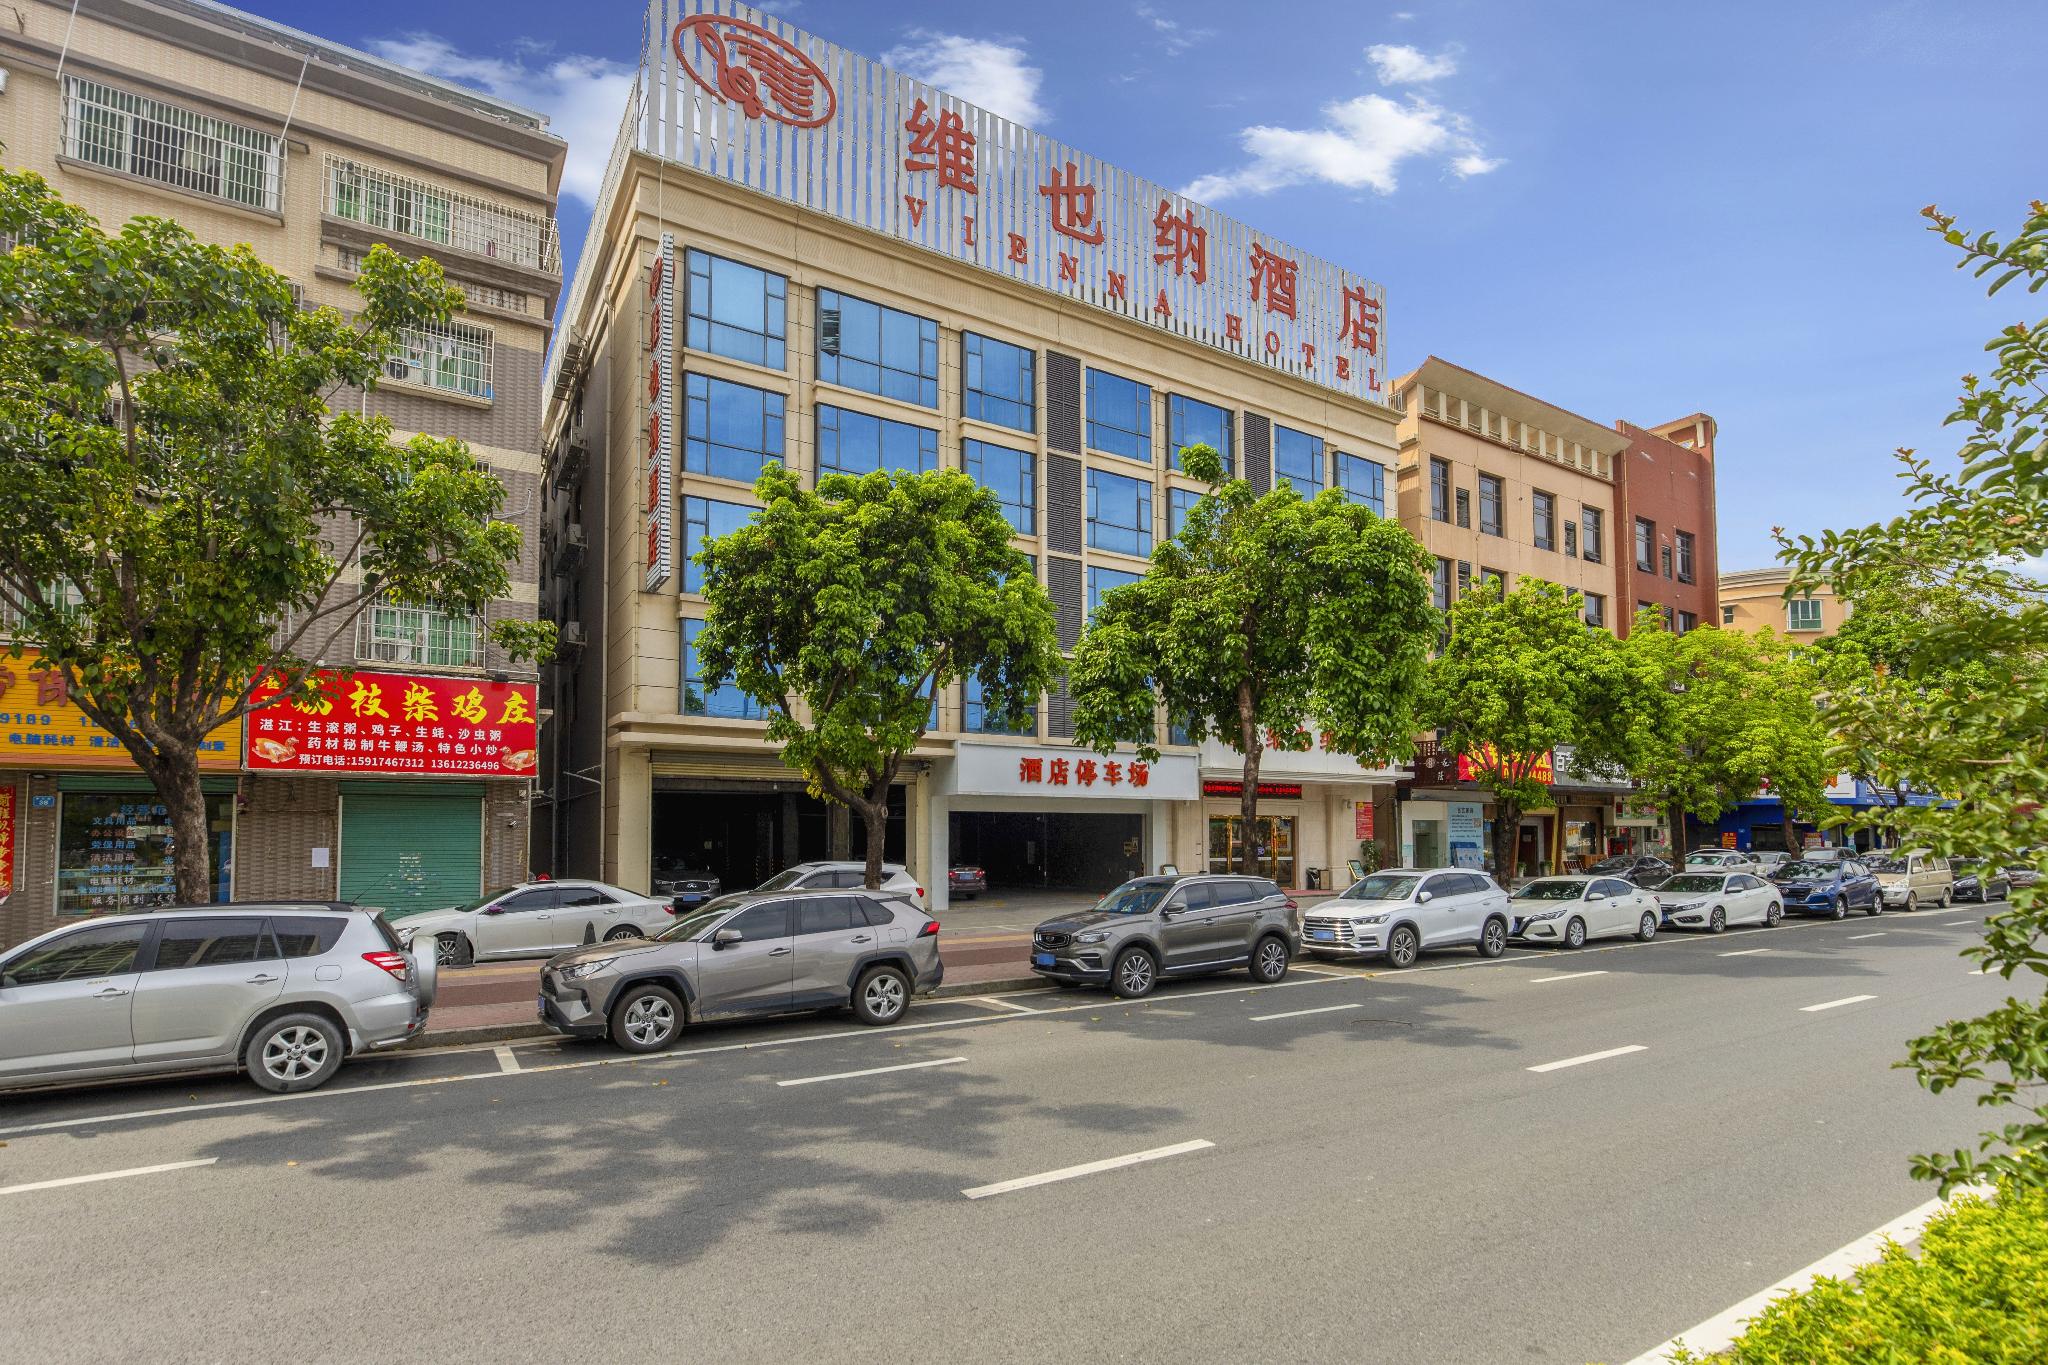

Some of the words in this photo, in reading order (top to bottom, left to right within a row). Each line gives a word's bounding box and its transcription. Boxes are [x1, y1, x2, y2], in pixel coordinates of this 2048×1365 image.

[904, 97, 1380, 357] 维也纳酒店
[904, 194, 1172, 317] VIENNA
[1225, 313, 1381, 393] HOTEL
[431, 759, 500, 771] 13612236496
[1019, 757, 1149, 787] 酒店停车场
[92, 816, 137, 826] 文具用品
